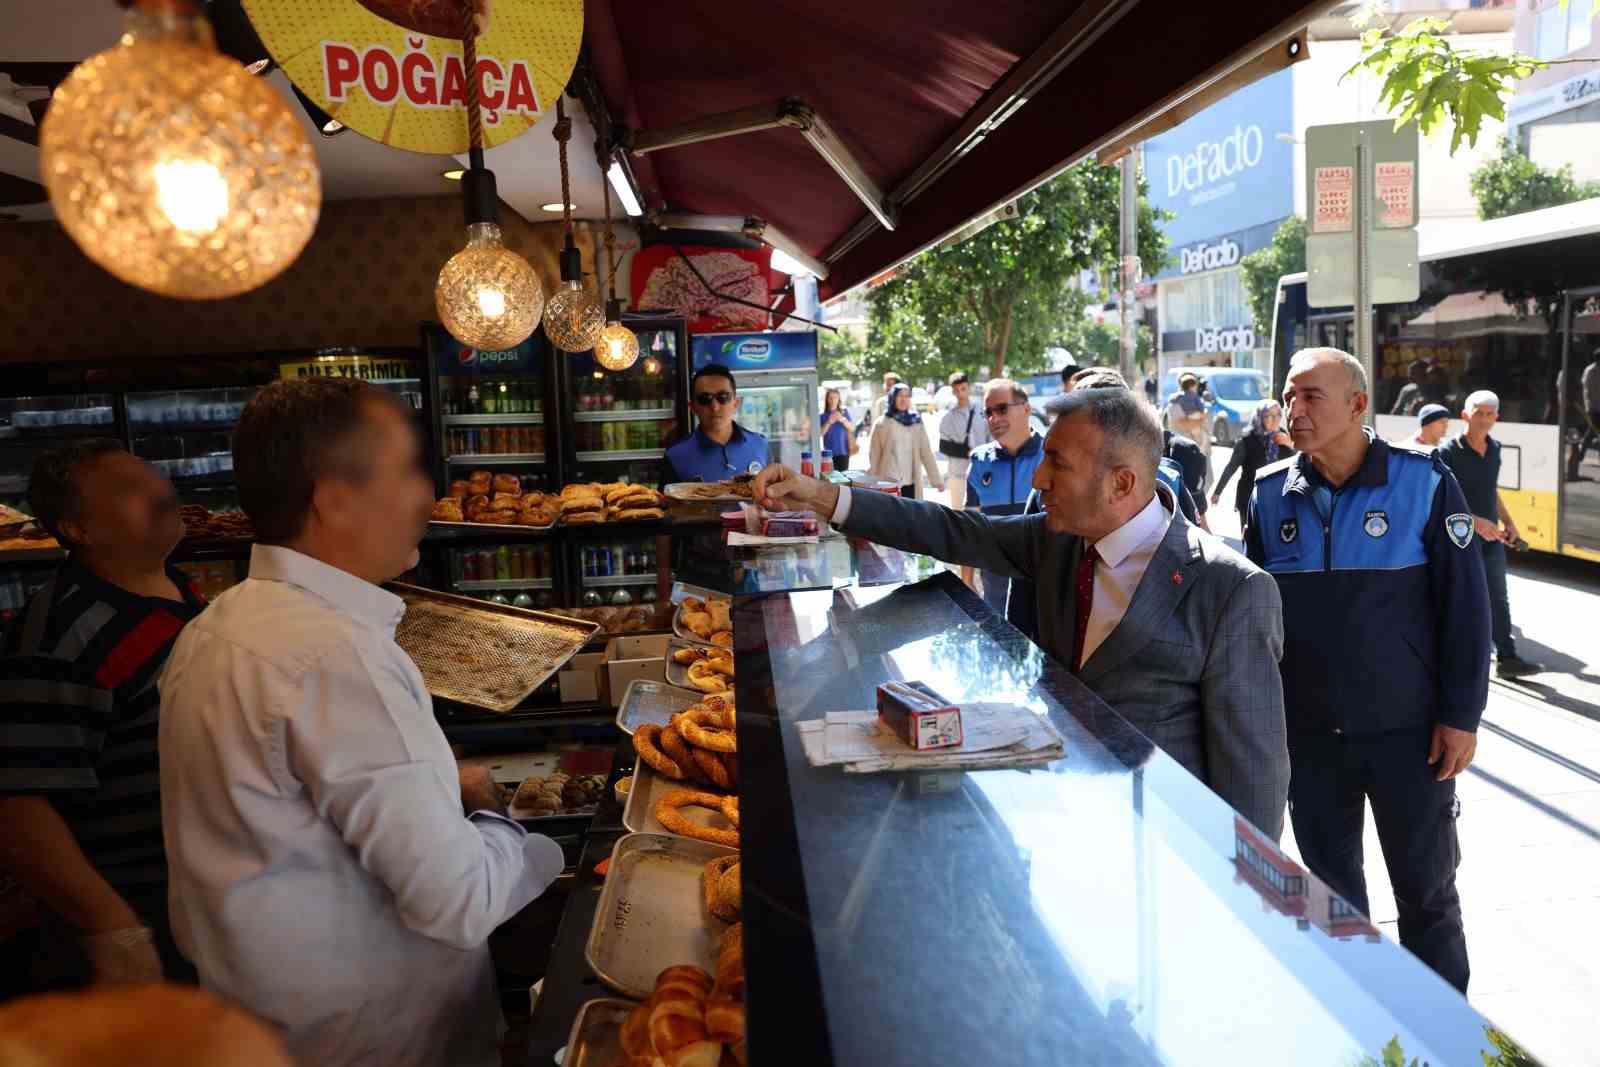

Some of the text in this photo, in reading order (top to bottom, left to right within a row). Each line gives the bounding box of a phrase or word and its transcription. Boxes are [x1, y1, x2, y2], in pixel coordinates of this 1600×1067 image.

[324, 36, 539, 124] POĞAÇA
[1167, 123, 1263, 198] DeFacto
[1181, 239, 1239, 274] DeFacto
[479, 350, 519, 362] pepsi
[1195, 324, 1255, 353] DeFacto
